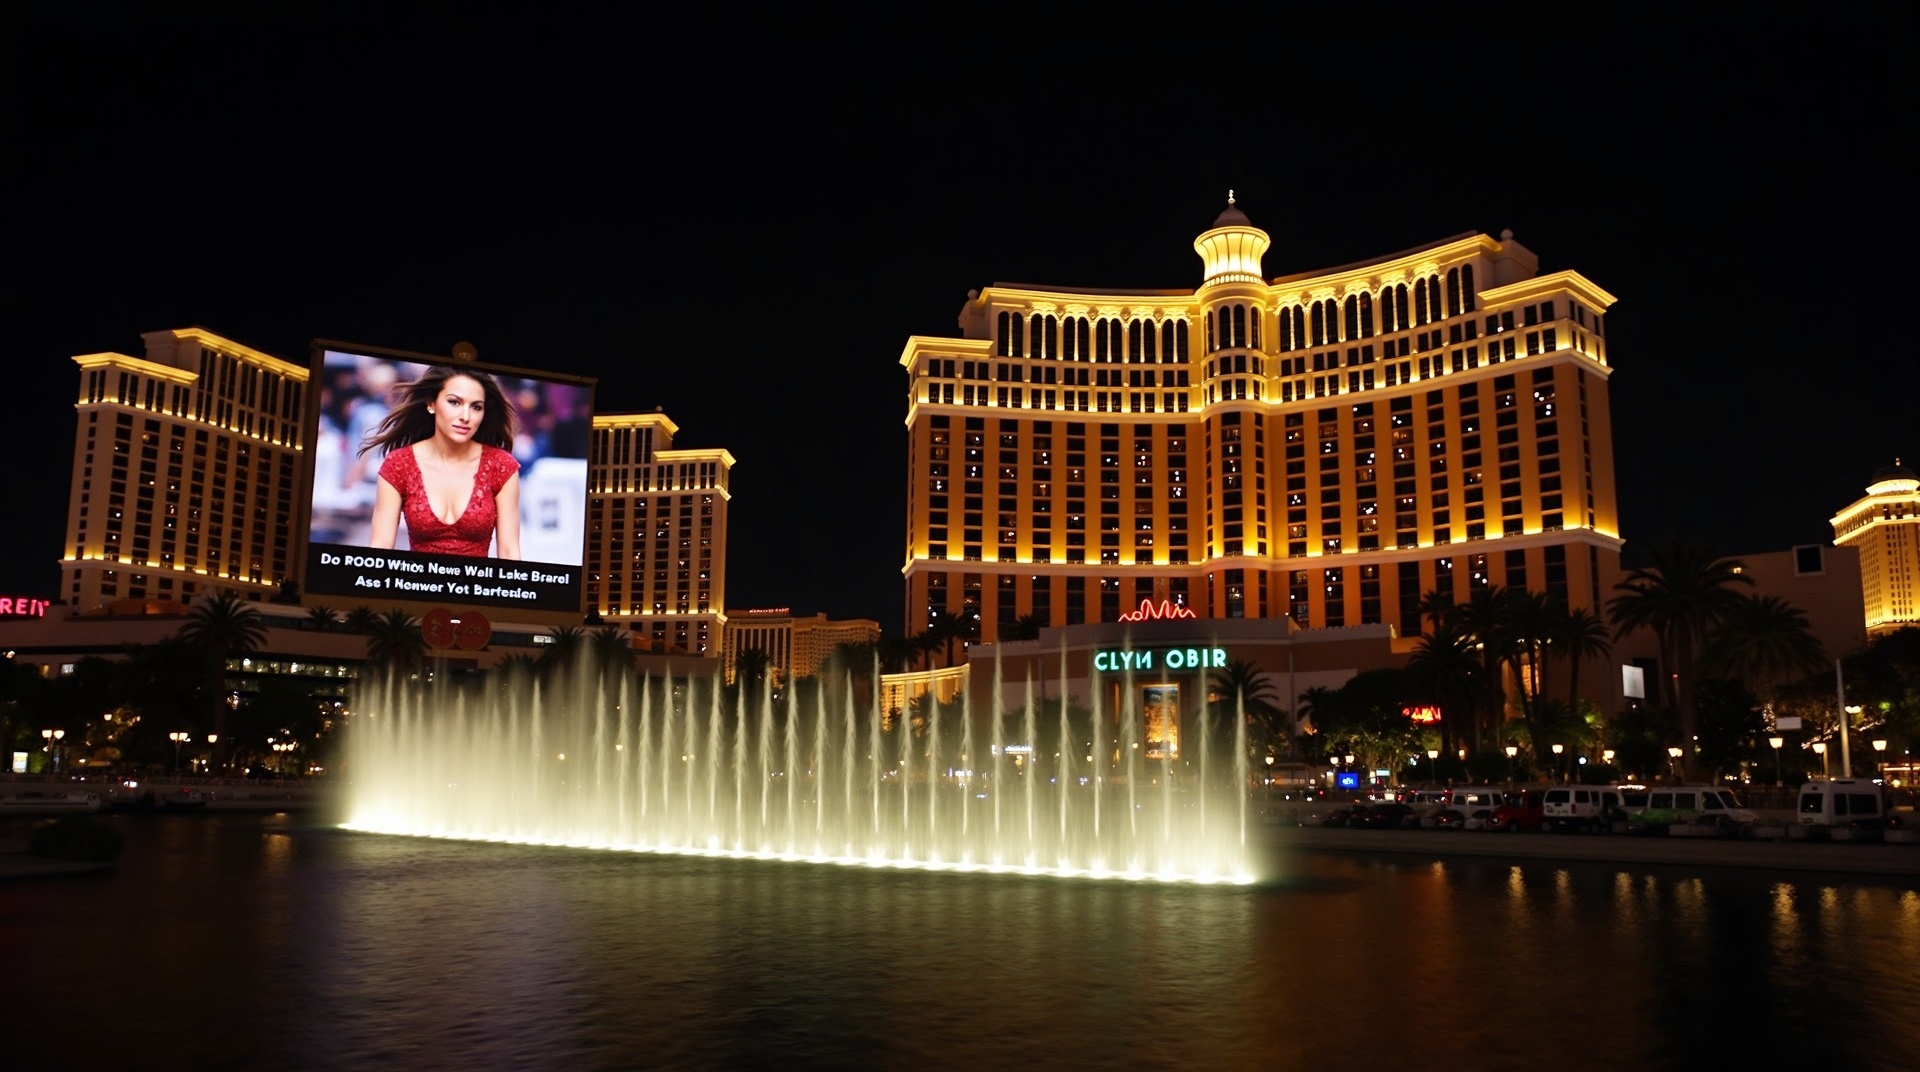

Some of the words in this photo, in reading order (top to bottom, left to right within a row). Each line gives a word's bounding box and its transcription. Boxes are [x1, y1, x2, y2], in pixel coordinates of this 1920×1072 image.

[321, 552, 341, 566] Do
[344, 555, 385, 569] ROOD
[1165, 648, 1227, 669] OBIR
